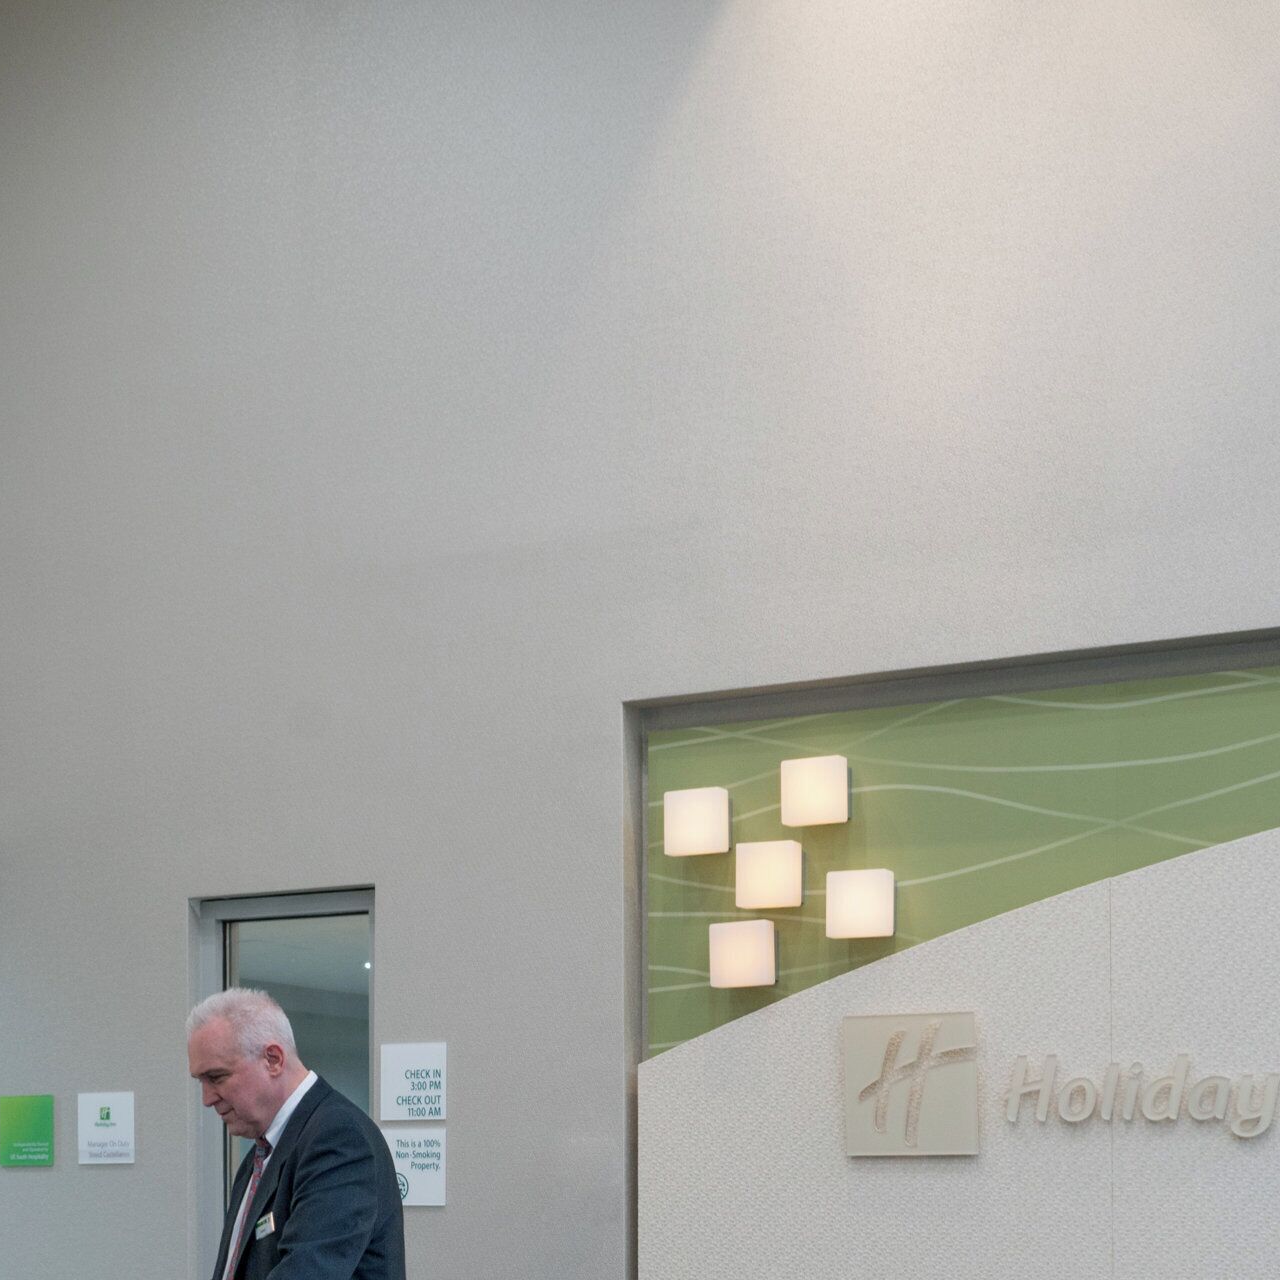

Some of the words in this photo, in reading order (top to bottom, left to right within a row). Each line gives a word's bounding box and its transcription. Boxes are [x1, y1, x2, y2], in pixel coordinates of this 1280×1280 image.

[404, 1069, 430, 1080] CHECK
[432, 1068, 442, 1079] IN
[410, 1081, 427, 1091] 3:00
[429, 1080, 442, 1090] PM
[396, 1095, 422, 1106] CHECK
[424, 1095, 441, 1105] OUT
[1006, 1052, 1280, 1139] Holiday
[407, 1107, 426, 1117] 11:00
[428, 1106, 442, 1116] AM
[396, 1139, 410, 1149] This
[411, 1139, 416, 1149] is
[423, 1138, 441, 1148] 100%
[410, 1161, 441, 1173] Property.
